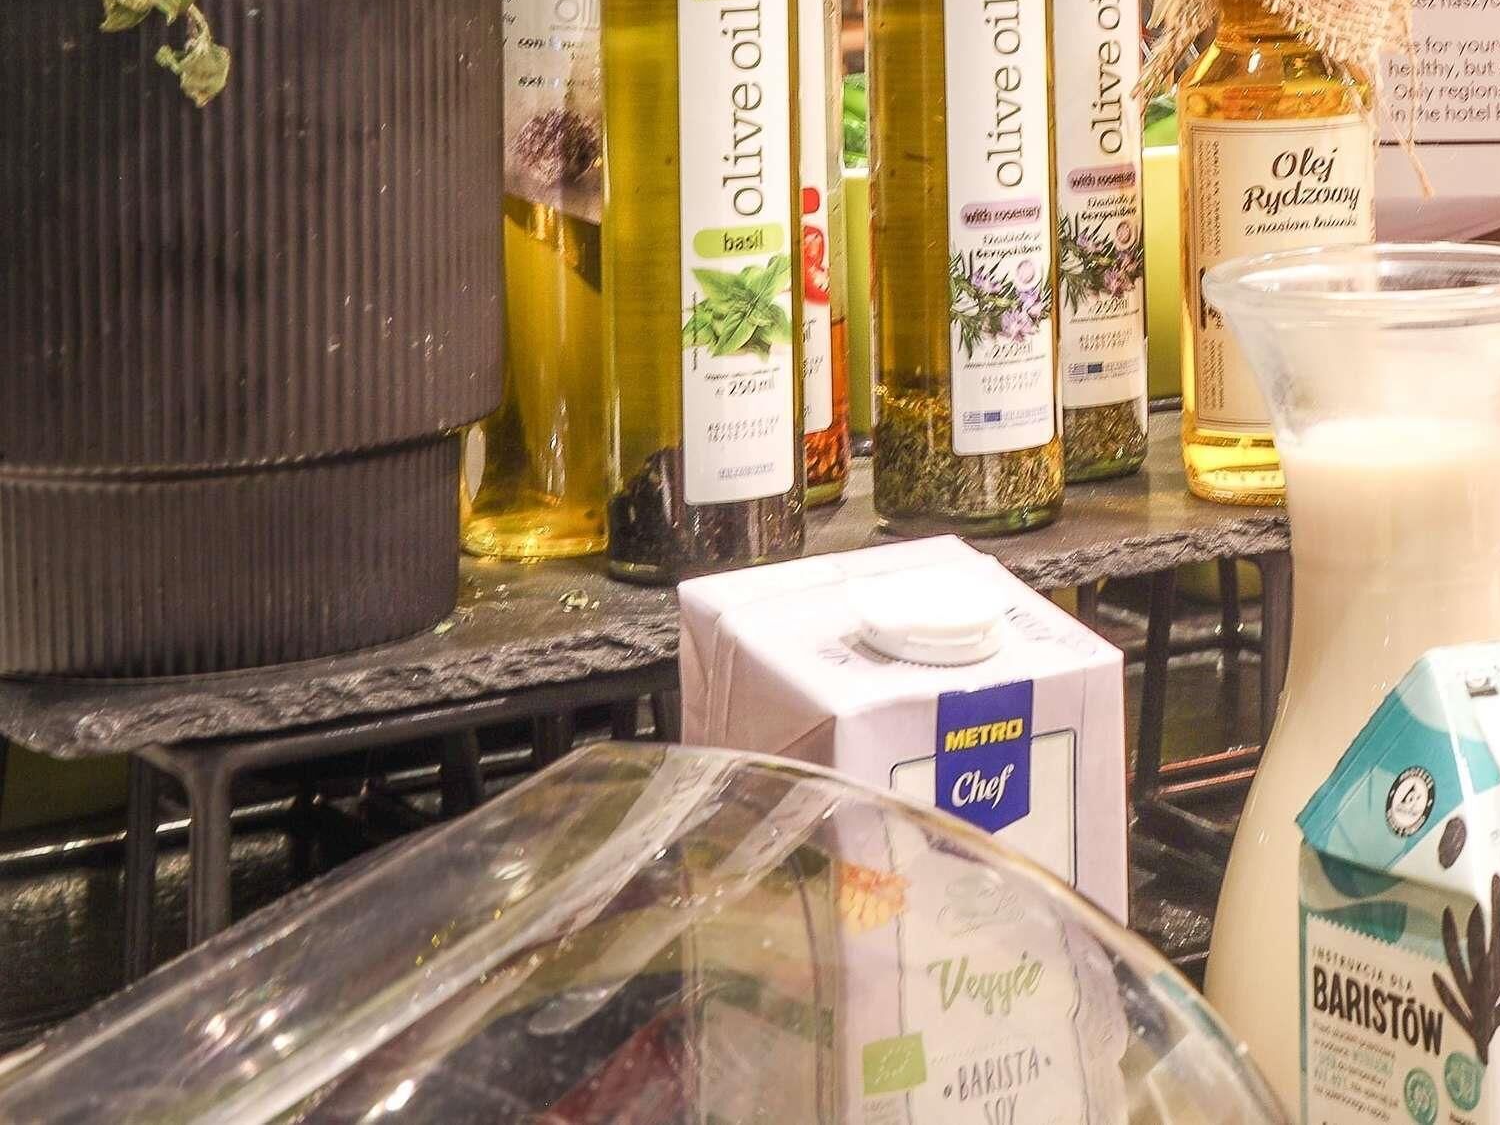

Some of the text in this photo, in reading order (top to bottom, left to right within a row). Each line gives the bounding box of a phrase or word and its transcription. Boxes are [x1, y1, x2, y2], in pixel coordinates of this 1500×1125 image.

[720, 0, 762, 71] oil
[1425, 36, 1451, 53] for
[1464, 57, 1494, 76] but
[1091, 39, 1122, 155] olive
[1390, 104, 1406, 123] in
[1445, 104, 1490, 122] hotel
[986, 65, 1024, 187] olive
[722, 83, 764, 217] olive
[1271, 146, 1339, 183] Olej
[1241, 179, 1361, 216] Rydzowy
[722, 228, 764, 253] basil
[945, 717, 1024, 753] METRO
[951, 763, 1015, 809] Chef
[927, 950, 1043, 1016] Veggie
[1312, 962, 1444, 1056] BARISTÓW
[957, 1045, 1040, 1102] BARISTA
